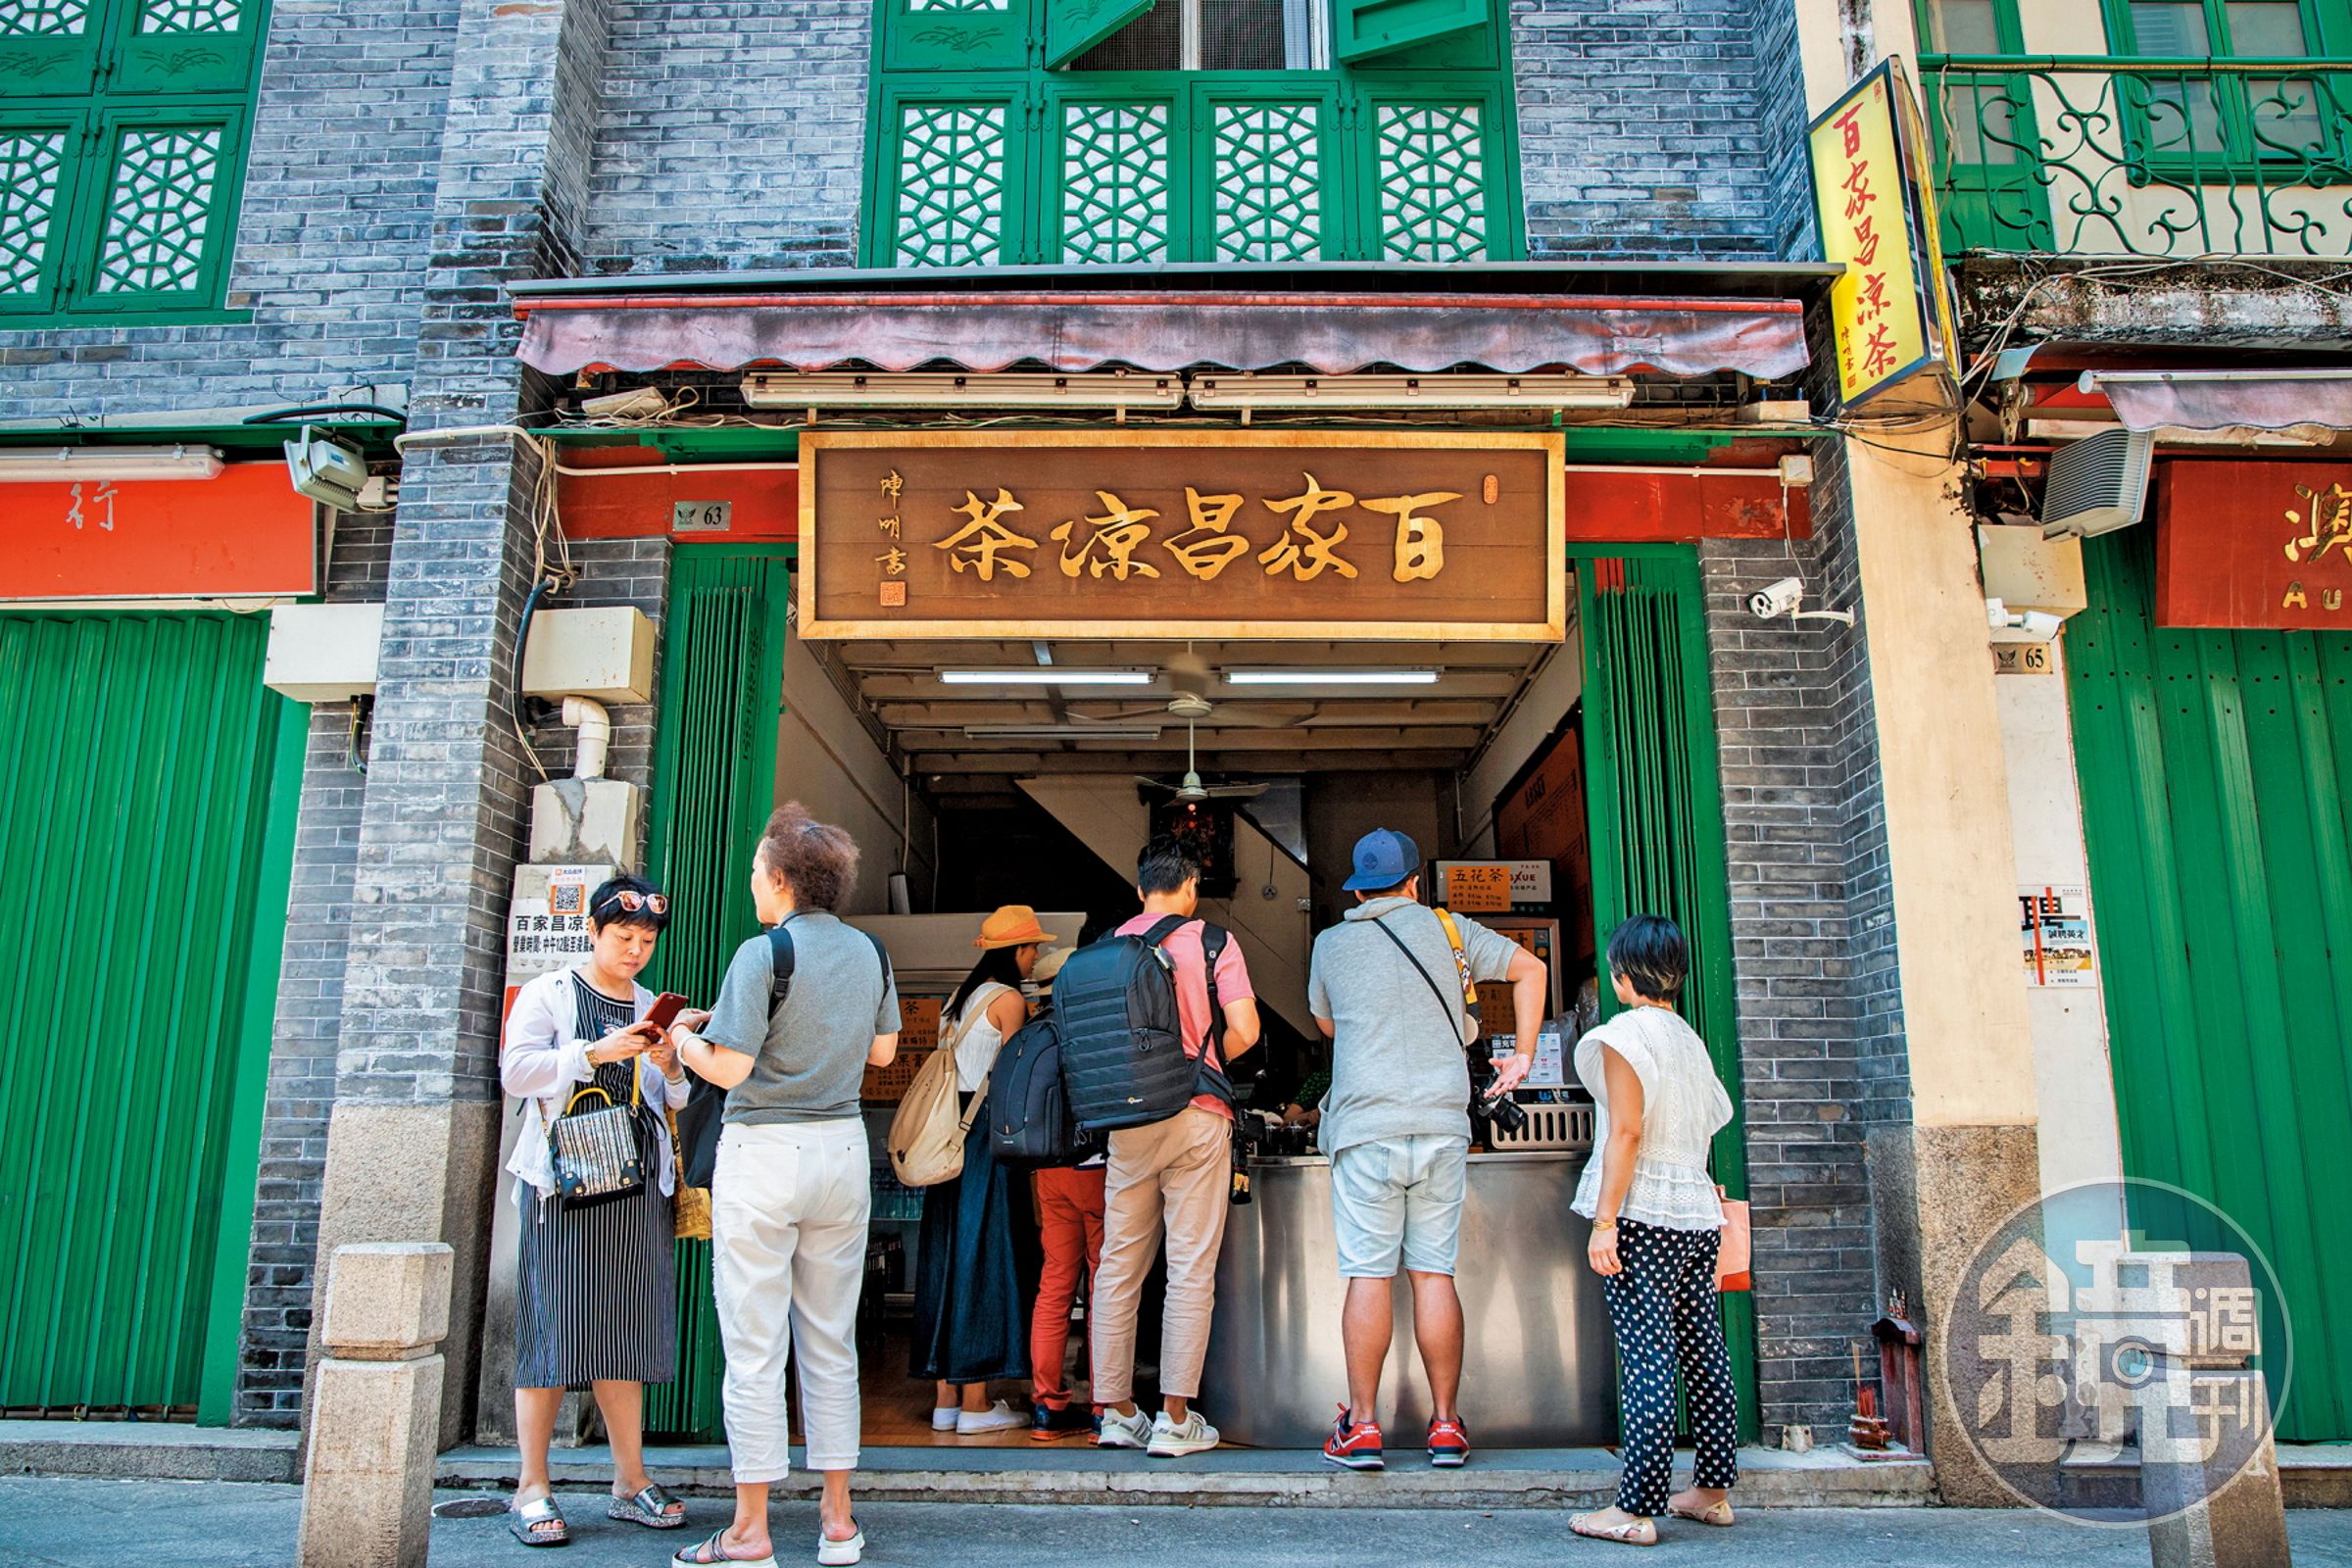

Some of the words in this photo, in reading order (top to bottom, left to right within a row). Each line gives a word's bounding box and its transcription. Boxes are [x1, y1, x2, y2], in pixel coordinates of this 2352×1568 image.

[704, 506, 722, 525] 63
[2026, 648, 2044, 668] 65
[1452, 868, 1503, 882] 五花茶
[515, 914, 589, 932] 百家昌凉
[905, 1002, 919, 1015] 茶
[891, 1054, 924, 1067] 果膏
